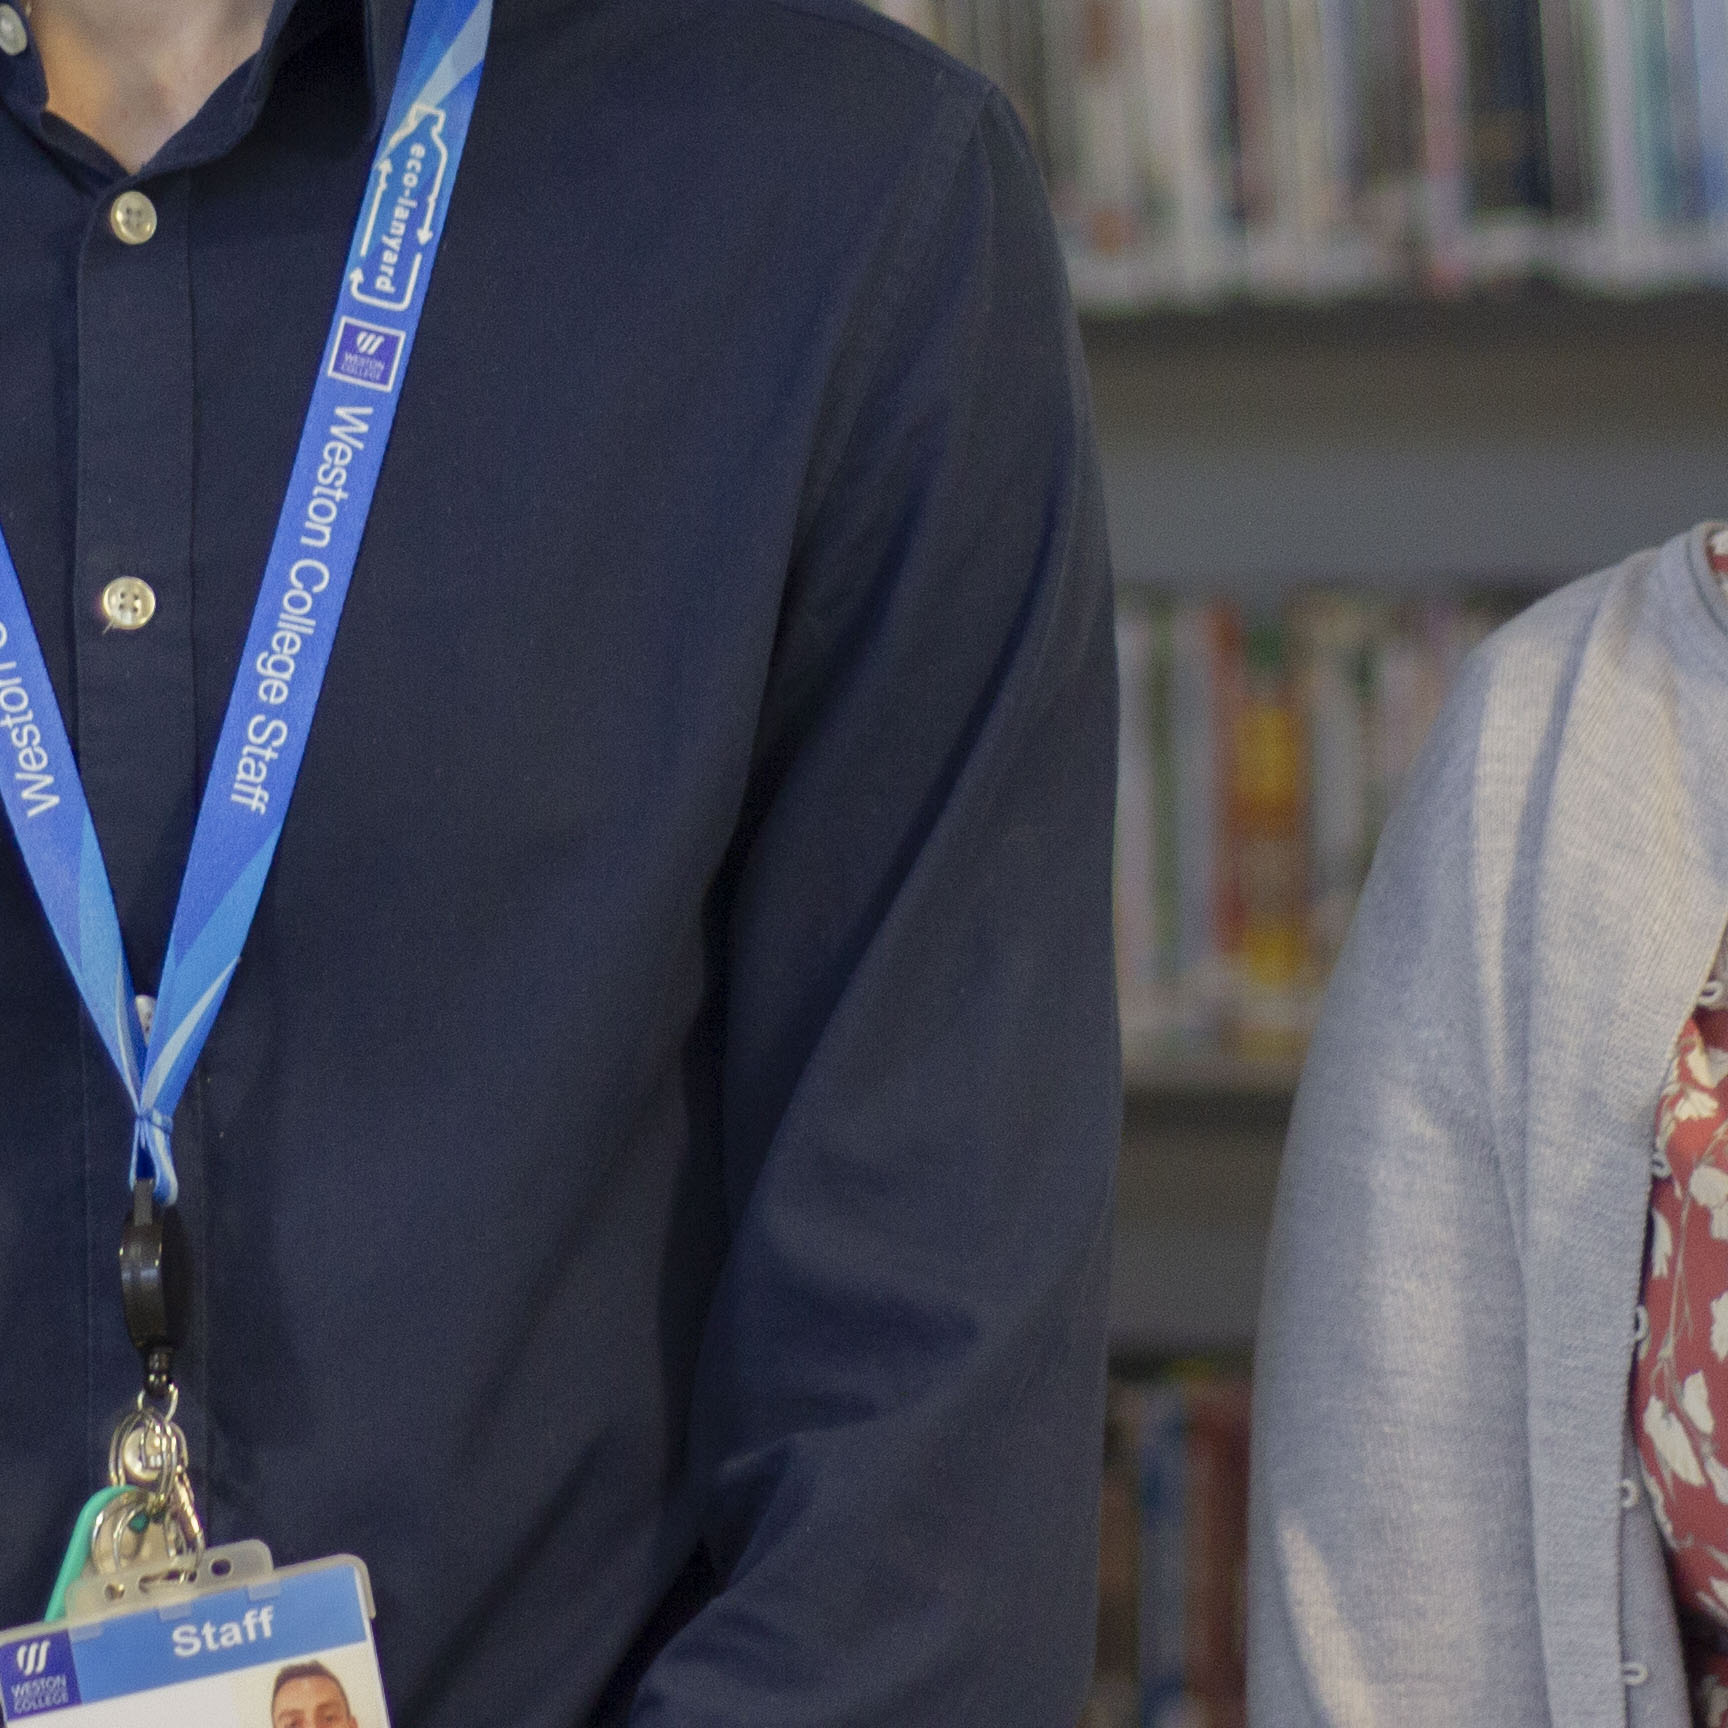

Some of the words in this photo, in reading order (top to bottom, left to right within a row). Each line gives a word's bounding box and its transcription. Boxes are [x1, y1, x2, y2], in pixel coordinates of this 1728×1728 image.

[375, 143, 425, 293] eco-lanyard
[299, 406, 374, 548] Weston
[255, 558, 330, 705] College
[231, 714, 288, 815] Staff
[172, 1605, 274, 1657] Staff
[11, 1674, 67, 1698] WESTON
[14, 1691, 69, 1713] COLLEGE
